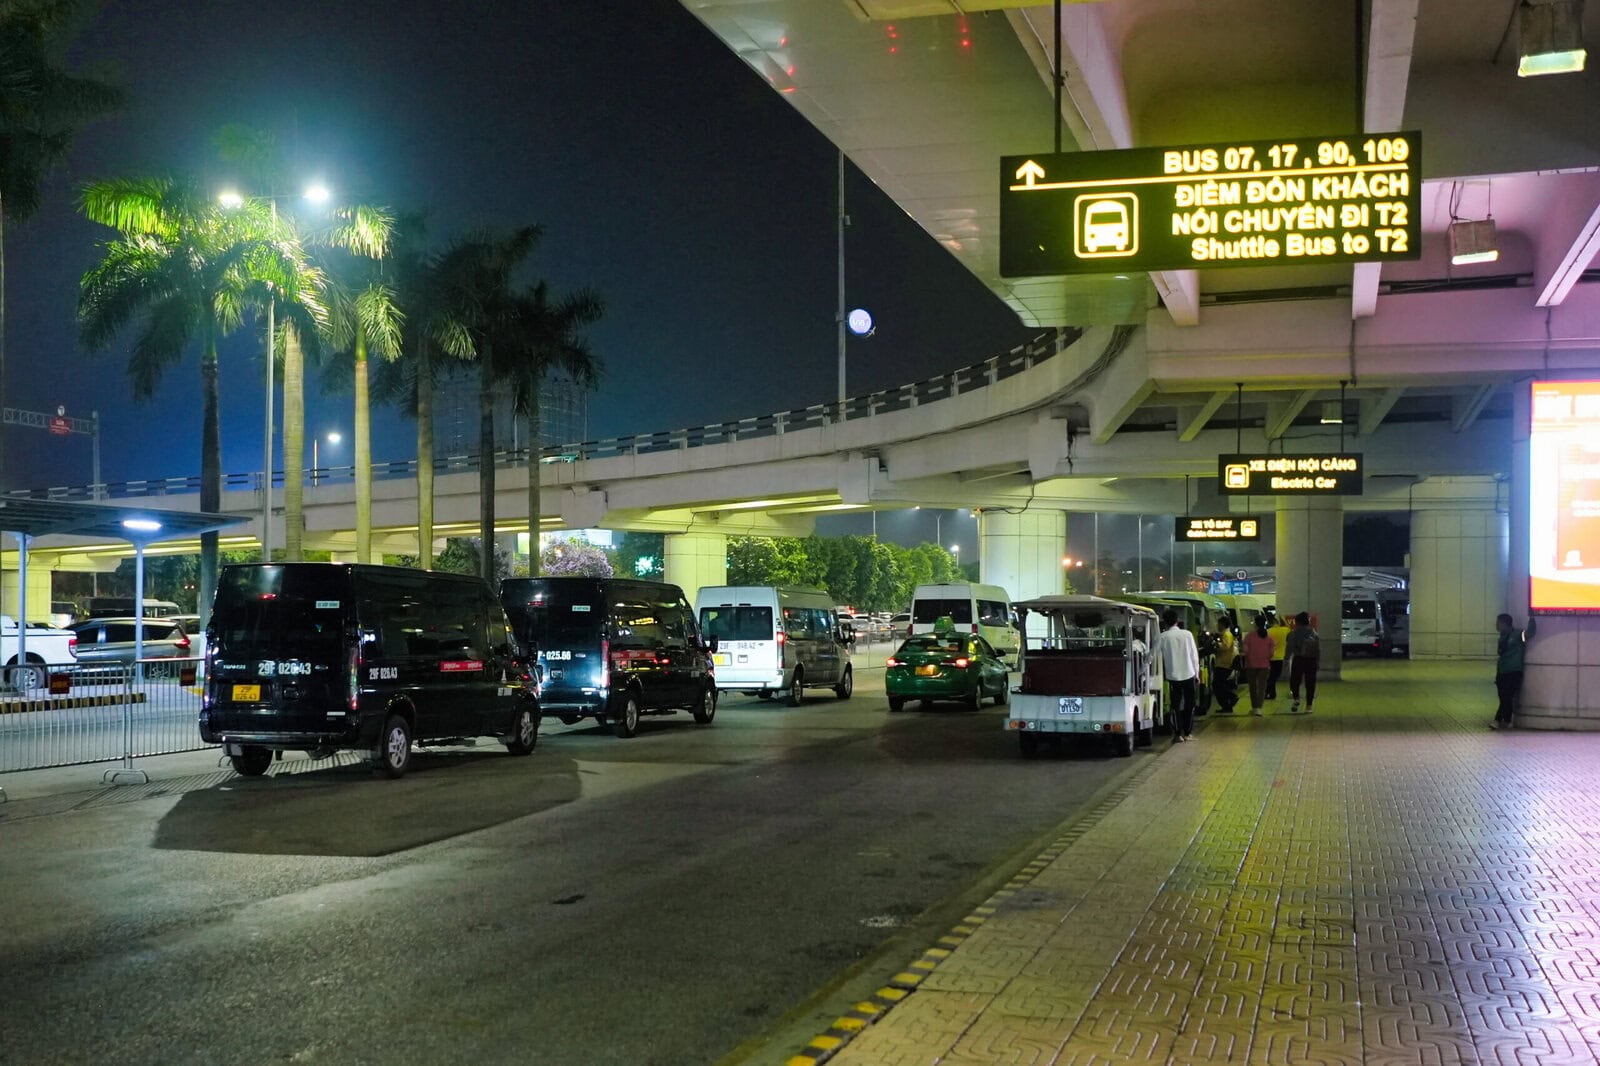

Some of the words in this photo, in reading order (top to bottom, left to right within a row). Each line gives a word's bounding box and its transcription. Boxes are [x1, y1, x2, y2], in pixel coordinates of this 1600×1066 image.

[1164, 149, 1218, 173] BUS
[1225, 148, 1261, 171] 07,
[1318, 142, 1355, 166] 90,
[1363, 139, 1409, 162] 109
[1340, 204, 1368, 227] ĐI
[1375, 202, 1407, 225] T2
[1192, 235, 1279, 260] Shuttle
[1286, 233, 1336, 256] Bus
[1342, 232, 1369, 253] to
[1374, 229, 1408, 252] T2
